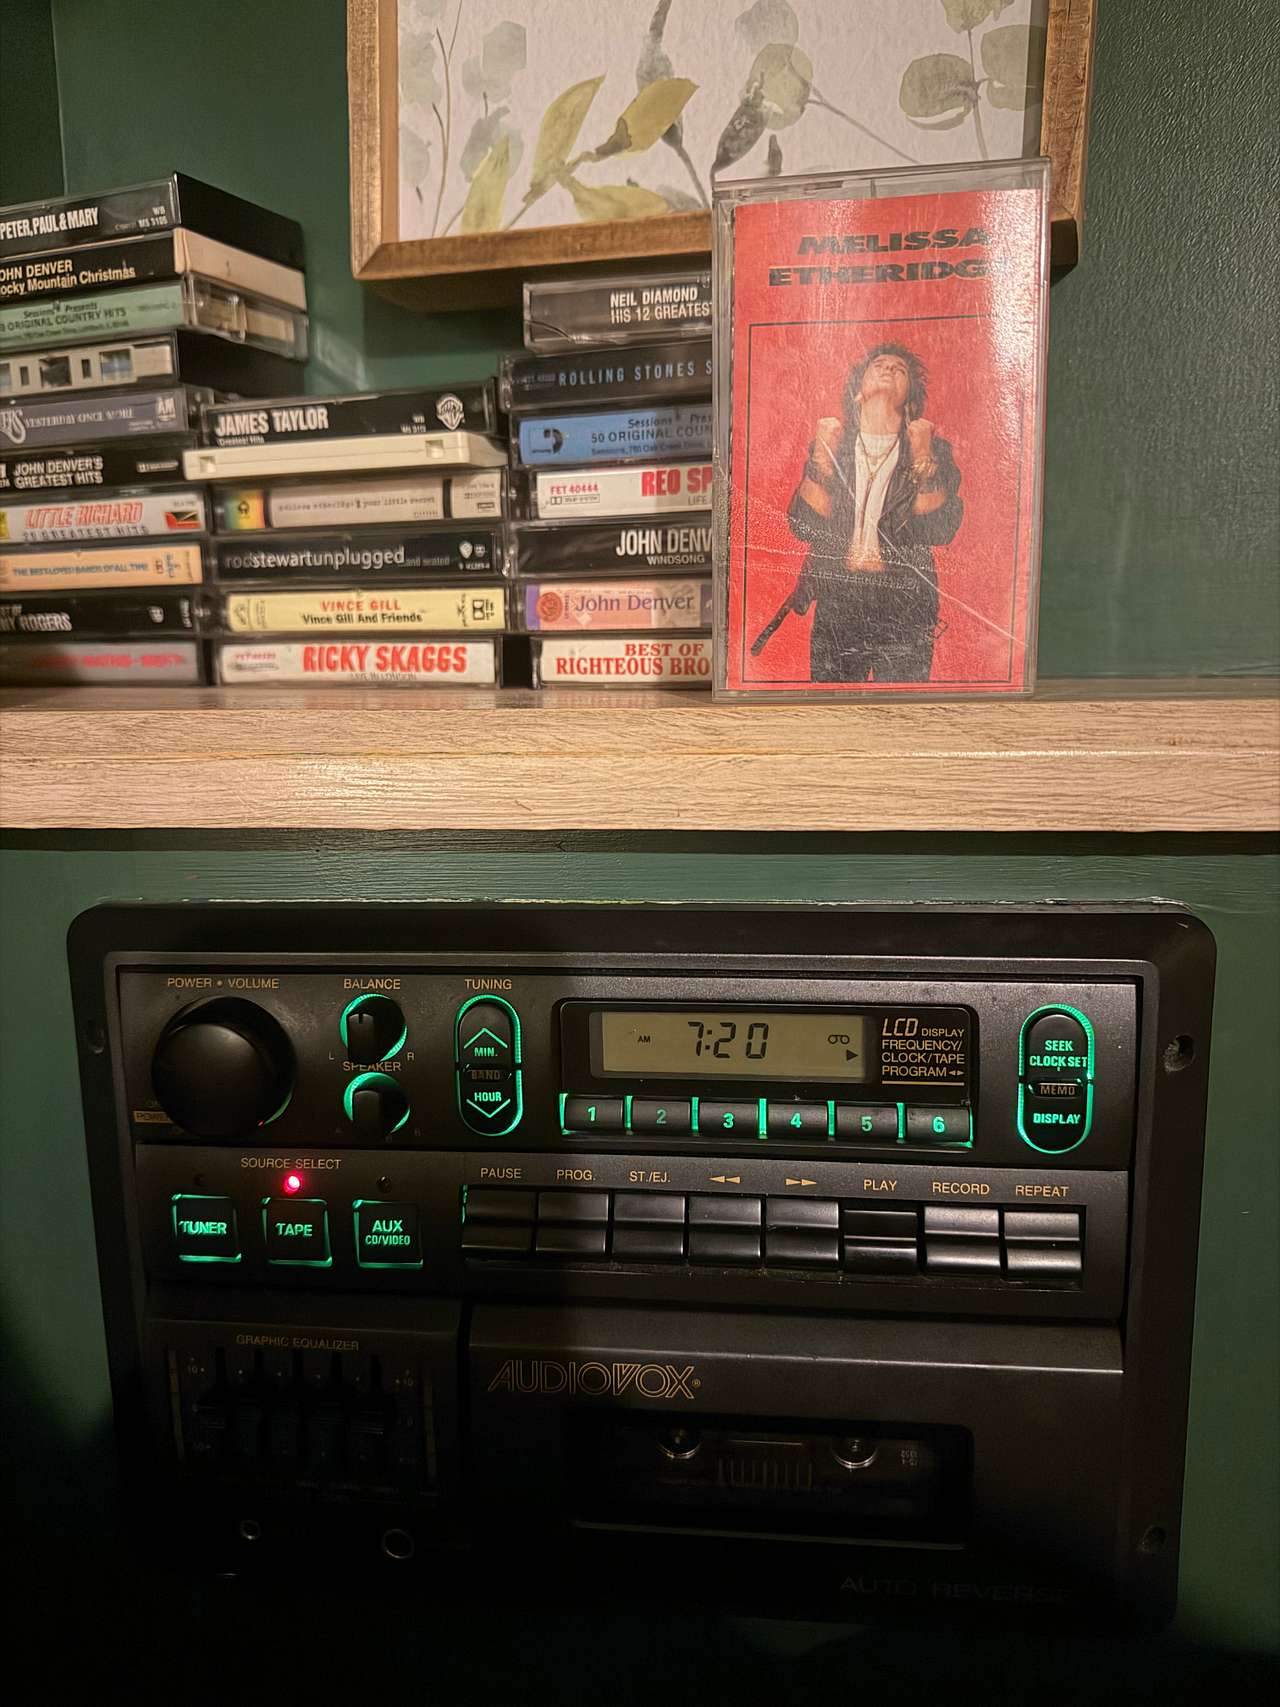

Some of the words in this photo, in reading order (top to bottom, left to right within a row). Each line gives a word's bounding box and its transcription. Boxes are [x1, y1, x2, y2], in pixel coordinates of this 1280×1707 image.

[33, 213, 59, 235] PAUL
[67, 207, 99, 227] MARY
[797, 226, 993, 256] MELISSA
[26, 259, 73, 279] DENVER
[768, 257, 998, 287] ETHERIDG
[27, 274, 77, 293] Mountain
[79, 265, 136, 286] Christmas
[609, 291, 638, 309] NEIL
[642, 286, 698, 305] DIAMOND
[7, 318, 53, 332] ORIGINAL
[55, 311, 101, 326] COUNTRY
[104, 307, 127, 319] HITS
[611, 308, 632, 324] HIS
[635, 306, 650, 321] 12
[558, 366, 625, 387] ROLLING
[634, 361, 695, 381] STONES
[215, 411, 269, 438] JAMES
[271, 406, 329, 433] TAYLOR
[628, 415, 674, 430] Sessions
[591, 432, 605, 444] 50
[608, 426, 673, 443] ORIGINAL
[14, 461, 45, 477] JOHN
[46, 455, 103, 474] DENVER'S
[15, 472, 73, 490] GREATEST
[75, 470, 103, 486] HITS
[641, 468, 681, 497] REO
[687, 466, 712, 494] SP
[551, 485, 567, 495] FET
[569, 483, 599, 494] 40444
[687, 495, 707, 505] LIFE
[25, 506, 75, 529] LITTLE
[76, 501, 144, 527] RICHARD
[615, 529, 662, 557] JOHN
[646, 553, 705, 566] WINDSONG
[320, 600, 364, 612] VINCE
[369, 598, 402, 611] GILL
[575, 594, 620, 611] John
[627, 593, 695, 612] Denver
[19, 611, 72, 631] ROGERS
[302, 612, 333, 625] Vince
[335, 612, 354, 624] Gill
[358, 611, 378, 624] And
[381, 611, 423, 623] Friends
[624, 643, 673, 657] BEST
[678, 643, 704, 656] OF
[303, 645, 371, 672] RICKY
[375, 645, 468, 673] SKAGGS
[556, 657, 663, 676] RIGHTEOUS
[669, 656, 711, 675] BRO
[166, 977, 213, 988] POWER
[228, 978, 280, 989] VOLUME
[343, 978, 401, 990] BALANCE
[464, 978, 512, 990] TUNING
[882, 1017, 919, 1037] LCD
[921, 1028, 965, 1038] DISPLAY
[637, 1035, 651, 1043] AM
[688, 1021, 769, 1060] 7:20
[881, 1039, 963, 1051] FREQUENCY/
[1044, 1040, 1074, 1052] SEEK
[328, 1051, 335, 1060] L
[407, 1051, 415, 1061] R
[474, 1047, 498, 1057] MIN.
[881, 1052, 965, 1065] CLOCK/TAPE
[343, 1060, 402, 1072] SPEAKER
[881, 1065, 947, 1077] PROGRAM
[471, 1070, 501, 1081] BAND
[474, 1091, 502, 1102] HOUR
[1040, 1085, 1076, 1096] MEMO
[587, 1106, 597, 1122] 1
[656, 1108, 667, 1124] 2
[722, 1112, 735, 1129] 3
[789, 1112, 802, 1129] 4
[1033, 1112, 1081, 1125] DISPLAY
[860, 1115, 873, 1132] 5
[932, 1116, 946, 1133] 6
[240, 1157, 291, 1169] SOURCE
[295, 1158, 343, 1170] SELECT
[480, 1167, 522, 1179] PAUSE
[556, 1169, 596, 1181] PROG.
[628, 1170, 671, 1183] ST./EJ.
[863, 1178, 897, 1191] PLAY
[932, 1182, 990, 1195] RECORD
[1015, 1184, 1069, 1198] REPEAT
[179, 1220, 227, 1235] TUNER
[276, 1222, 313, 1237] TAPE
[372, 1219, 404, 1233] AUX
[365, 1234, 411, 1246] CD/VIDEO
[236, 1333, 289, 1348] GRAPHIC
[292, 1336, 360, 1352] EQUALIZER
[487, 1359, 696, 1401] AUDIOVOX
